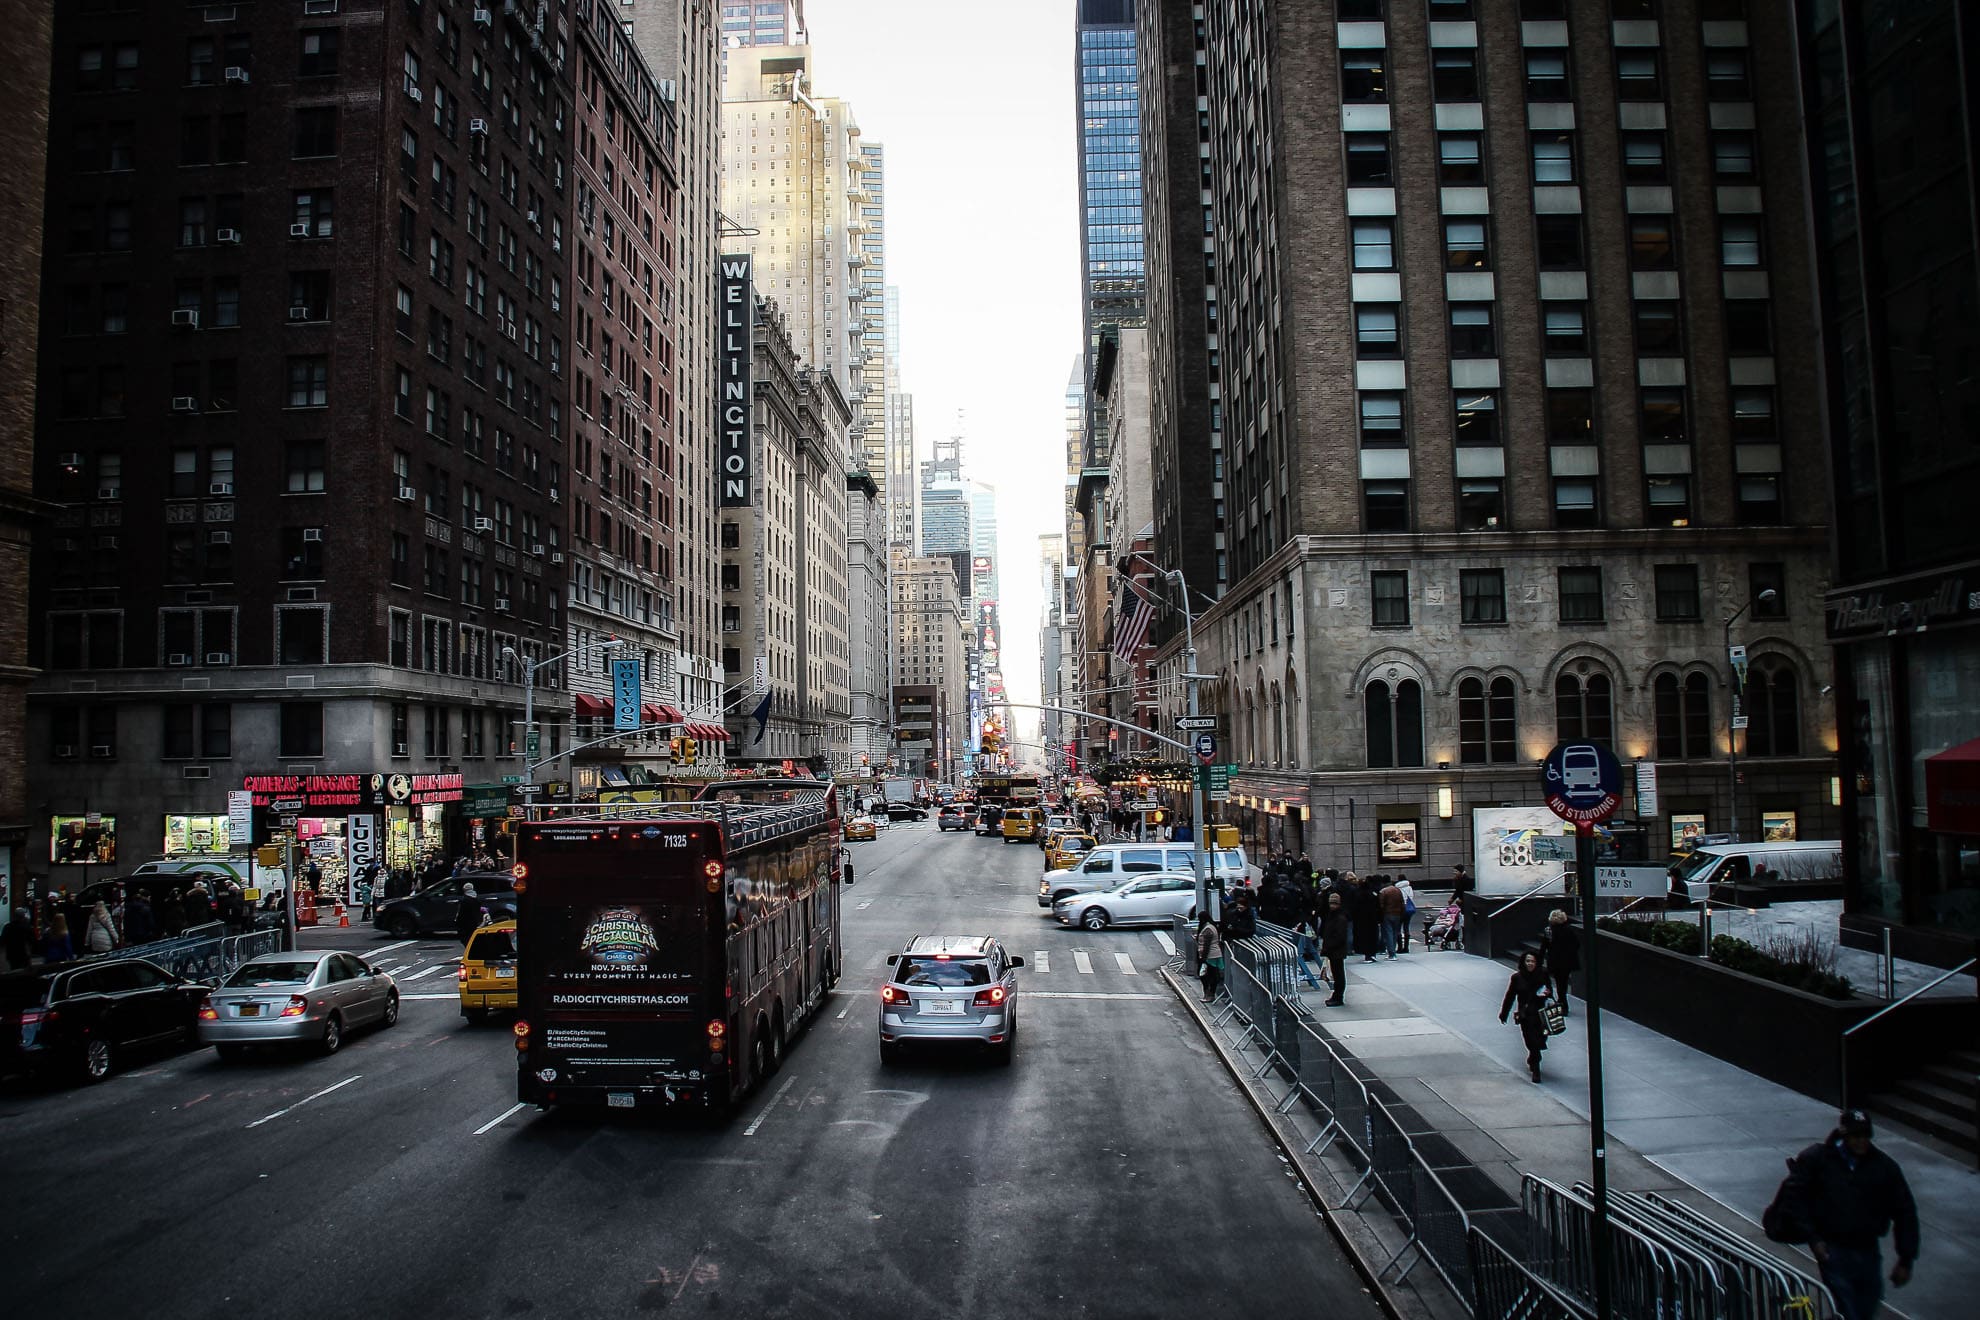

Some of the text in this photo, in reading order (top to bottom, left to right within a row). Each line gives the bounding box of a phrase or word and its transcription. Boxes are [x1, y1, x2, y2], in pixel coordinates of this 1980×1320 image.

[722, 262, 748, 498] WELLINGTON
[620, 663, 635, 723] MOLYVOS
[244, 776, 361, 792] CAMERAS LUGGAGE
[310, 794, 361, 805] ELECTRONICS
[1551, 796, 1616, 820] NO STANDING
[664, 835, 688, 848] 71325
[1600, 869, 1626, 877] 7 Av &
[1600, 880, 1632, 888] W 57 St
[622, 912, 637, 921] CITY
[591, 920, 649, 935] CHRISTMAS
[581, 931, 660, 951] SPECTACULAR
[592, 964, 610, 972] NOV.
[553, 994, 689, 1004] RADIOCITYCHRISTMAS.COM
